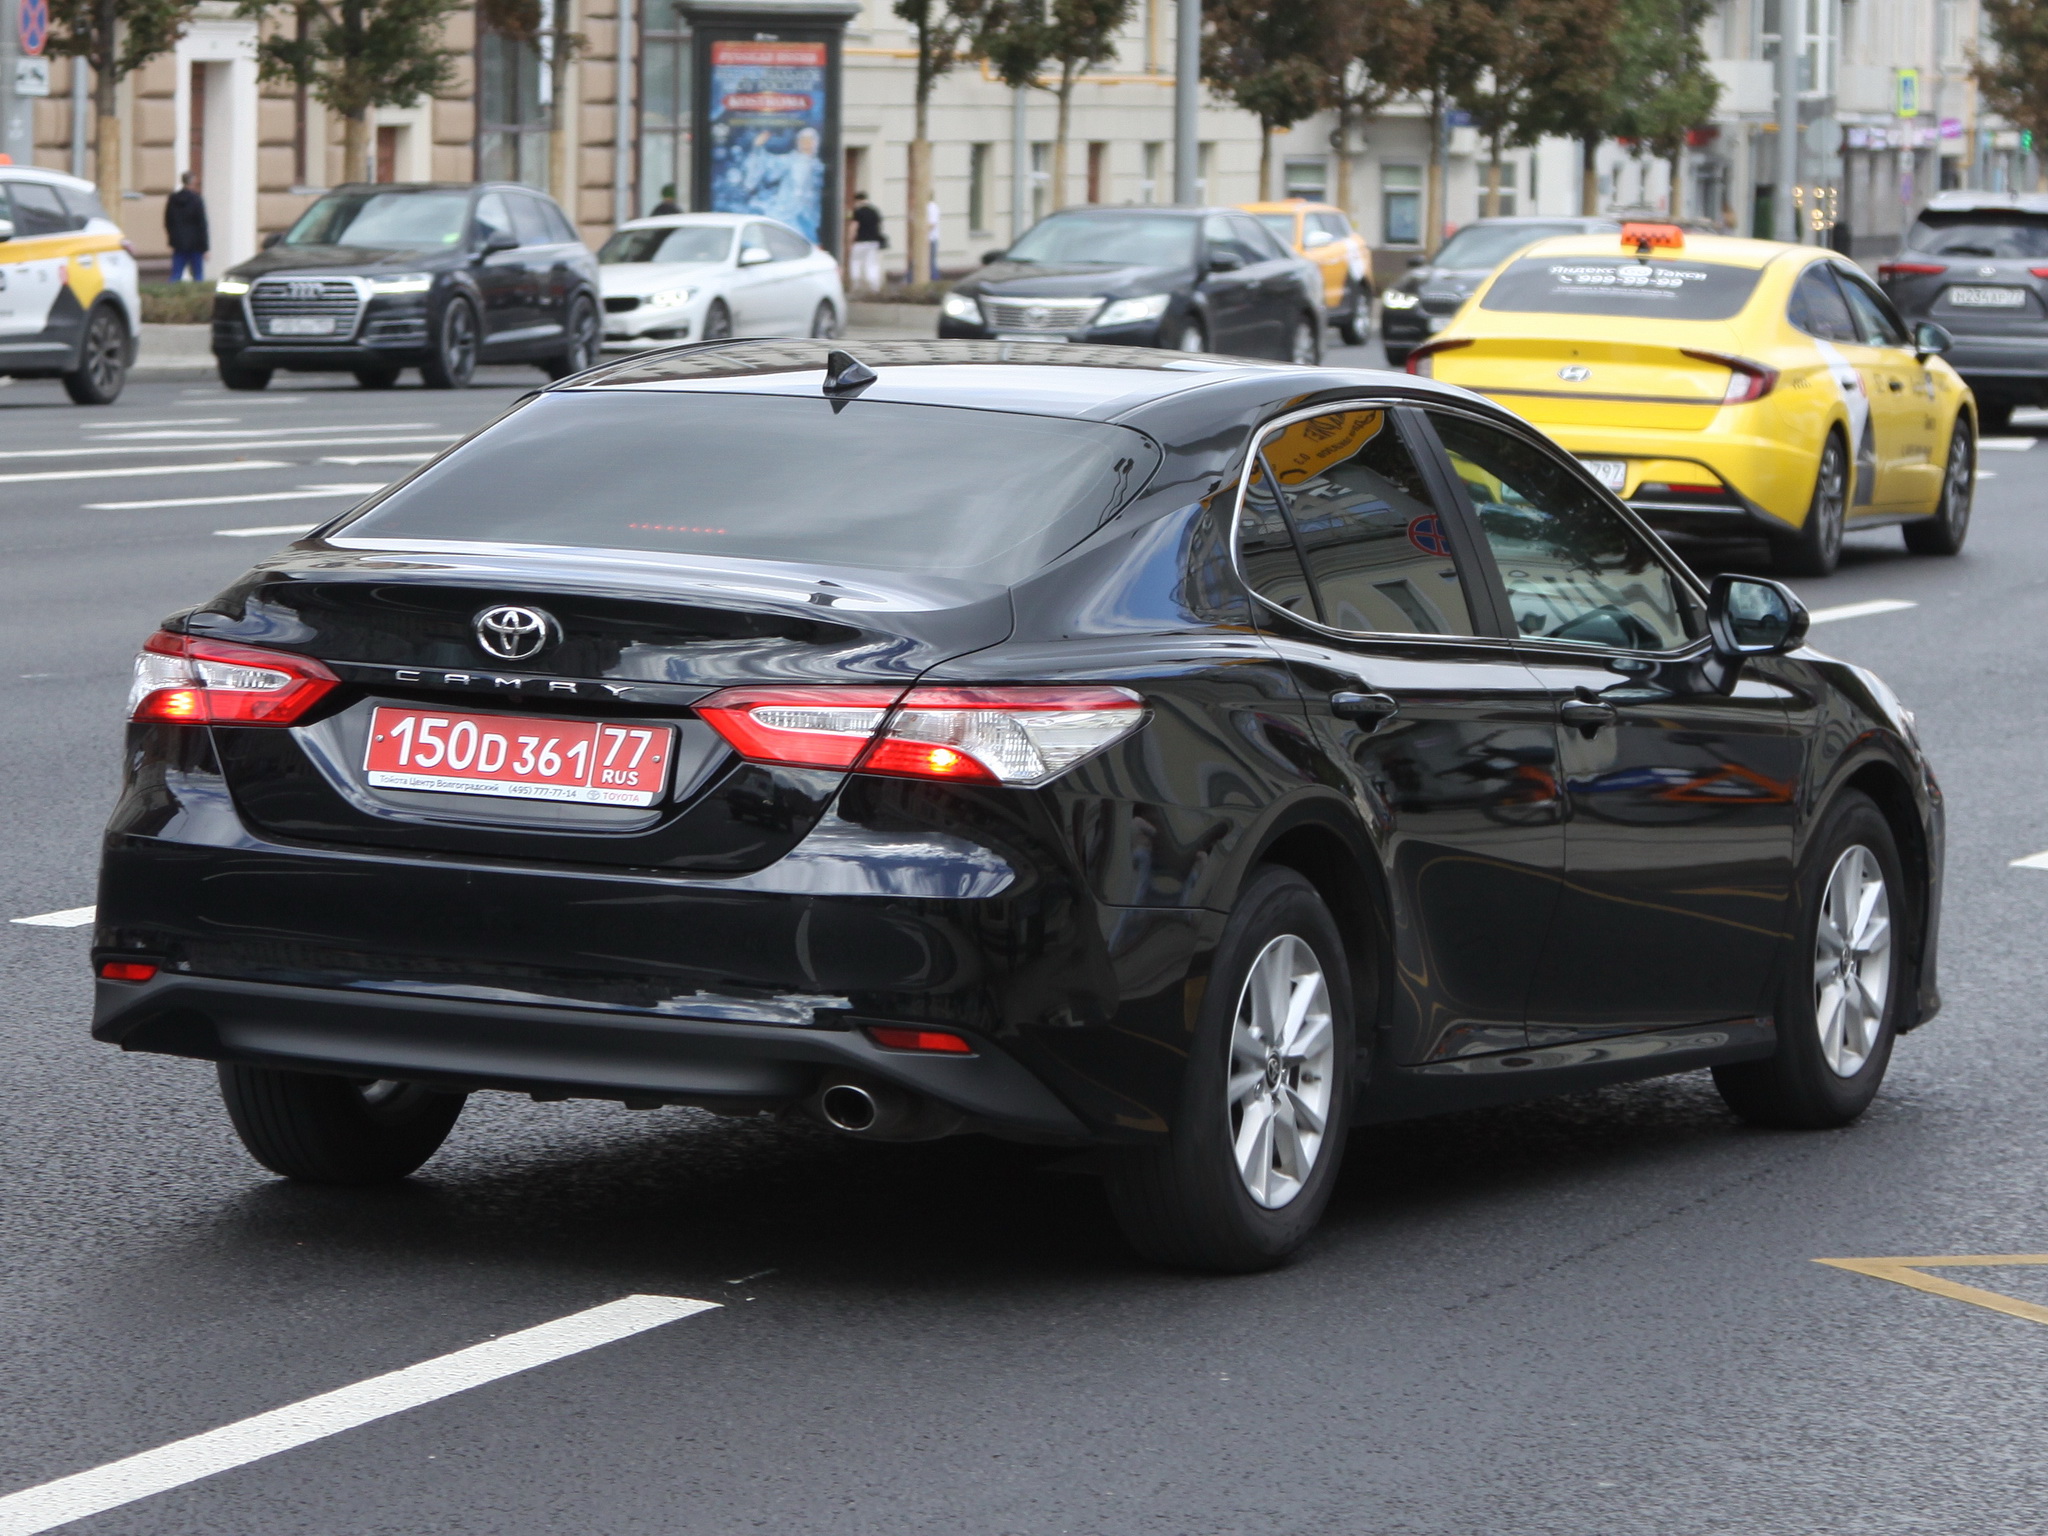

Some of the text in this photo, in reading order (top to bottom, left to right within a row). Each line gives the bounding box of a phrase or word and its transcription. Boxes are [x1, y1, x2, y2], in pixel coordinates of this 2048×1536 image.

[1550, 266, 1617, 275] Яндекс
[1655, 268, 1708, 281] Такси
[1576, 275, 1684, 289] 999-99-99
[395, 670, 635, 696] CAMRY
[602, 728, 653, 769] 77
[601, 769, 640, 786] RUS
[409, 777, 436, 789] Центр
[436, 780, 500, 792] Волгоградский
[508, 784, 533, 796] (495)
[533, 787, 577, 799] 777-77-14
[602, 791, 640, 803] TOYOTA
